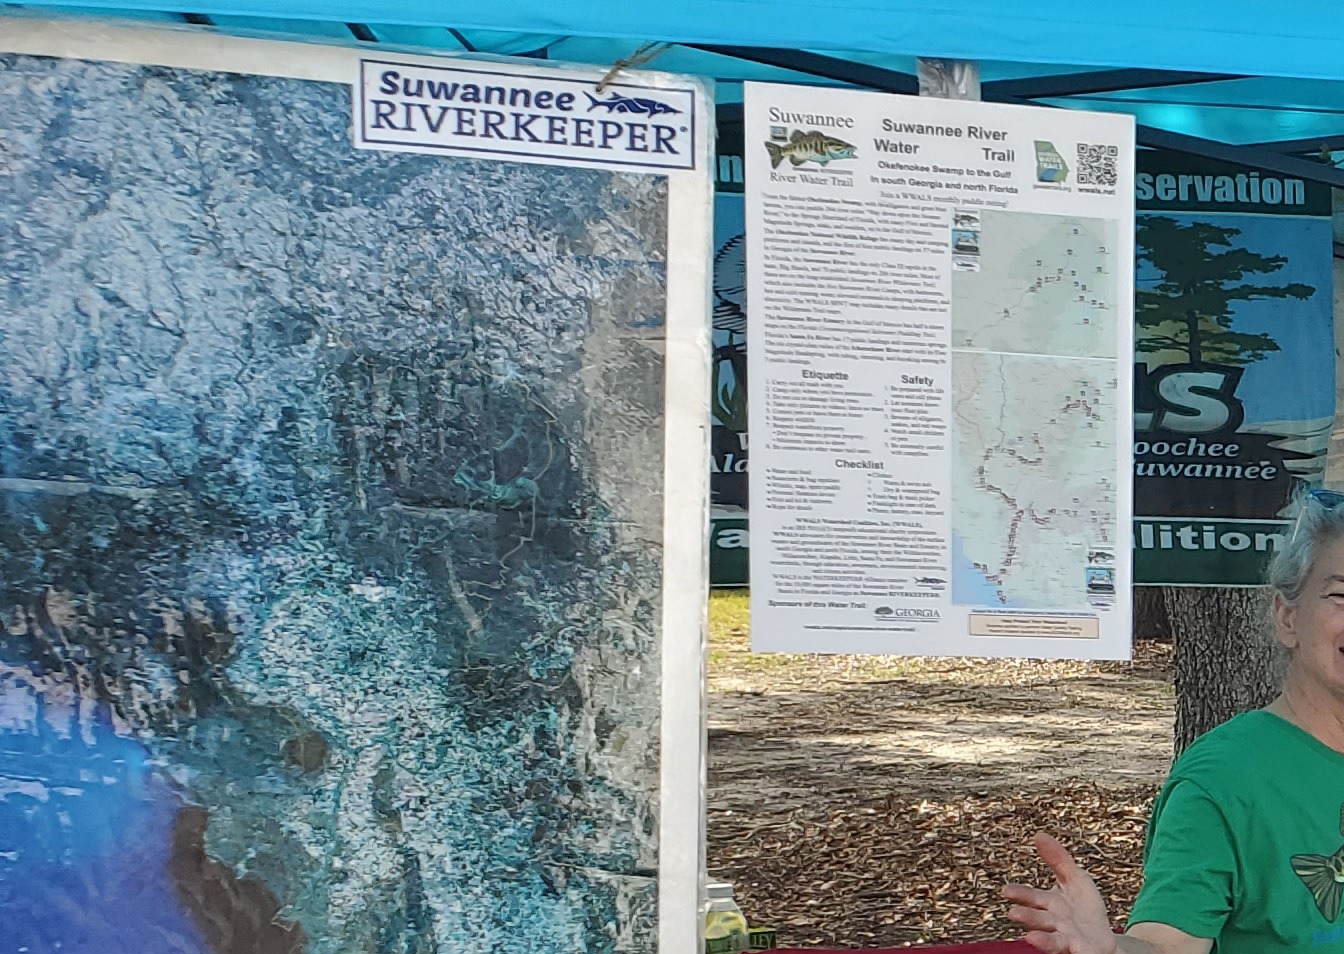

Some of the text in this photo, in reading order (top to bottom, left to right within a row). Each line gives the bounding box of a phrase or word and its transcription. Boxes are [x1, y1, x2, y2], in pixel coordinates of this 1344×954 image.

[379, 71, 576, 112] Suwannee
[769, 106, 855, 129] Suwannee
[882, 118, 1008, 142] Suwannee River
[873, 137, 1015, 163] Water Trail
[908, 178, 943, 190] Georgia
[1135, 170, 1306, 206] servation
[801, 369, 849, 381] Etiquette
[901, 375, 934, 387] Safety
[1135, 436, 1240, 458] oochee
[835, 458, 884, 470] Checklist
[1136, 459, 1278, 481] uwannee
[1136, 523, 1284, 552] lition
[895, 608, 941, 618] GEORGIA
